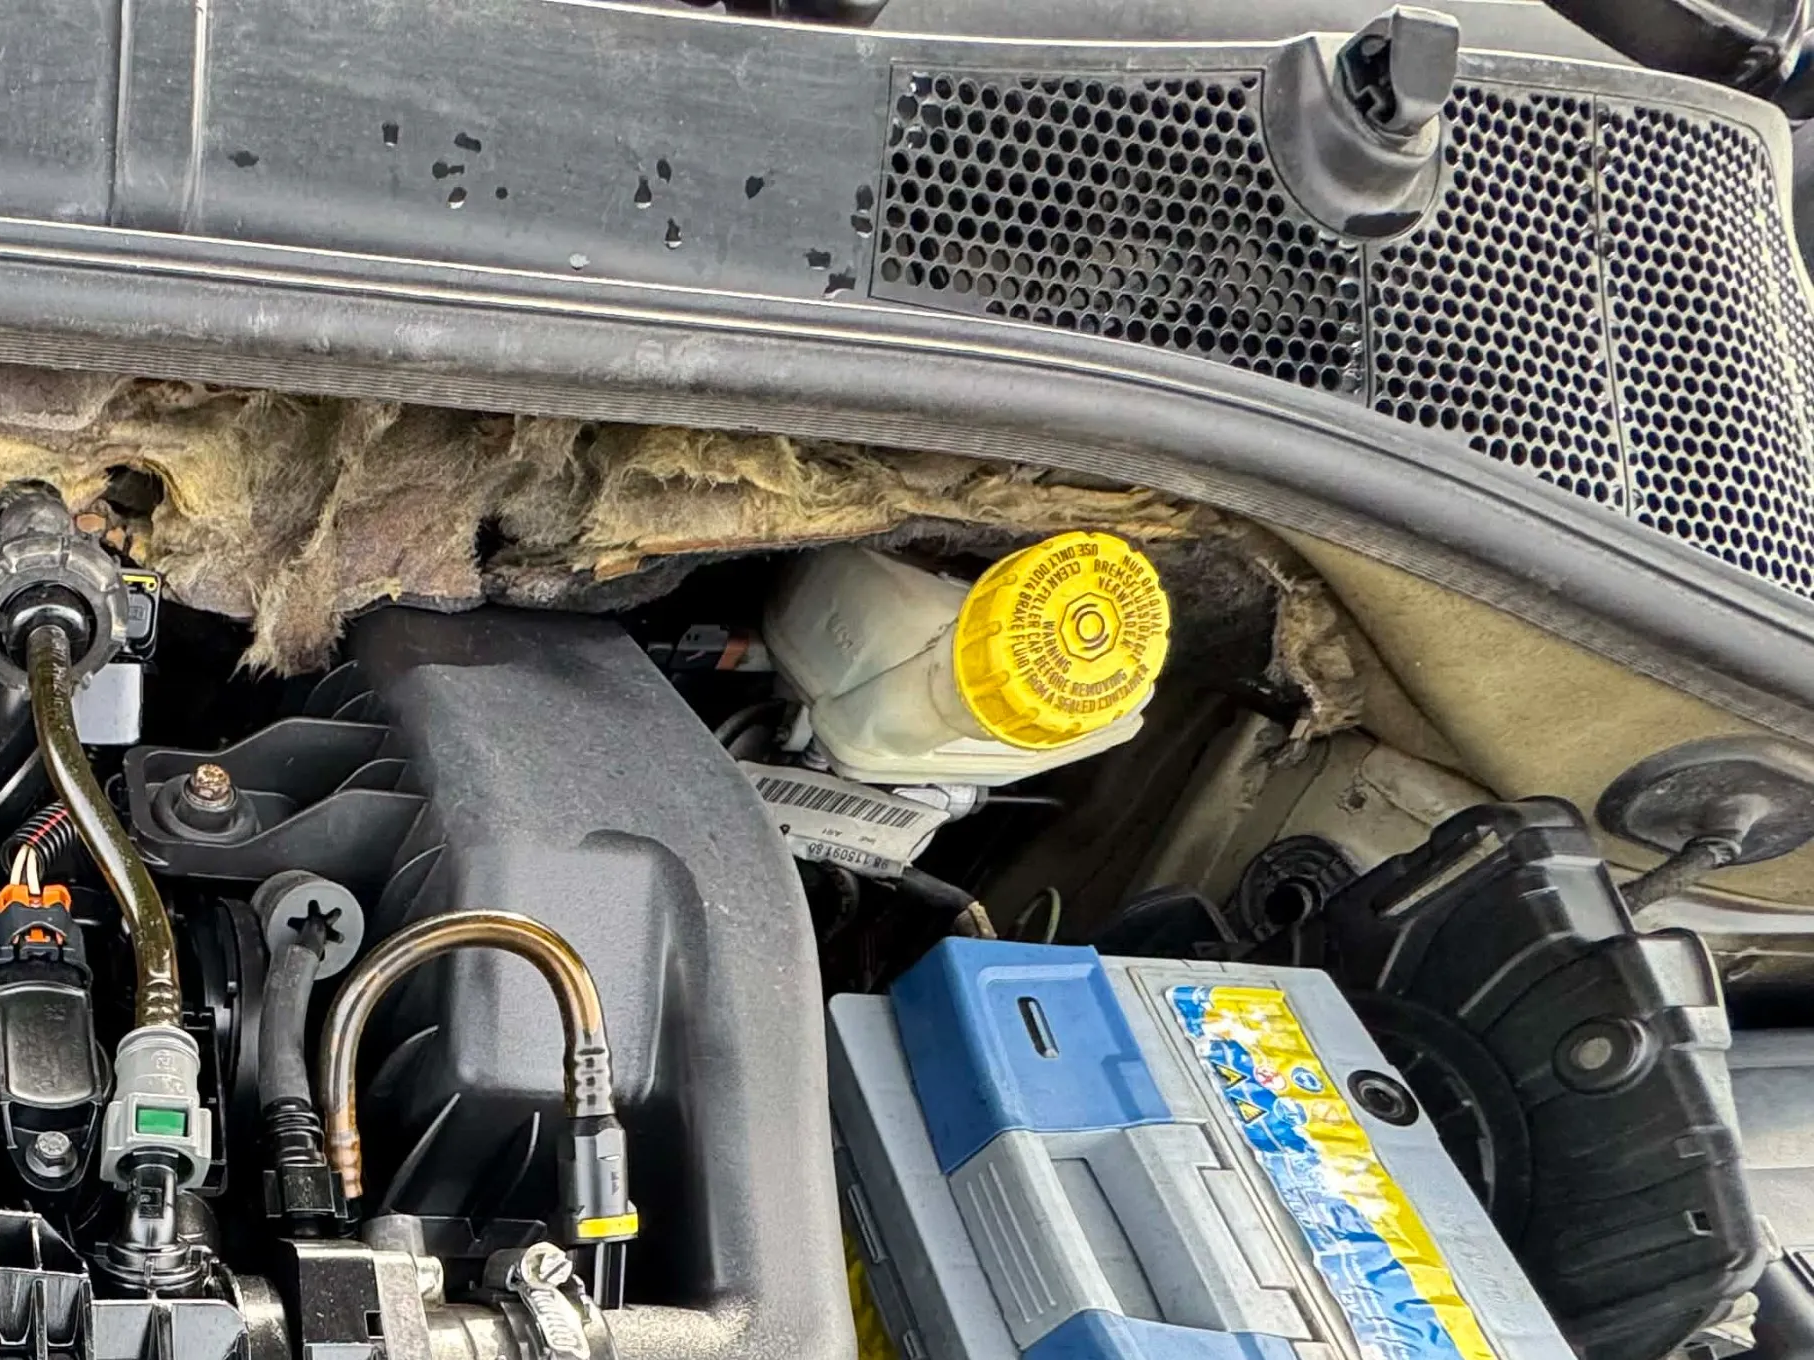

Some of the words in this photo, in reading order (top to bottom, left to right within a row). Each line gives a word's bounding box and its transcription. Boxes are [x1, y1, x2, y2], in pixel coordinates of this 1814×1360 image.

[1048, 548, 1076, 569] ONLY
[1079, 544, 1098, 557] USE
[1023, 563, 1051, 591] DOT4
[1050, 562, 1081, 593] CLEAN
[1123, 555, 1145, 576] NUR
[1010, 586, 1031, 631] BRAKE
[1028, 587, 1053, 629] FILLER
[1098, 576, 1136, 649] VERWENDEN
[1010, 634, 1030, 669] FLUID
[1027, 631, 1043, 654] CAP
[1042, 620, 1072, 674] WARNING
[1036, 655, 1068, 693] BEFORE
[1071, 669, 1128, 697] REMOVING
[1055, 695, 1096, 714] SEALED
